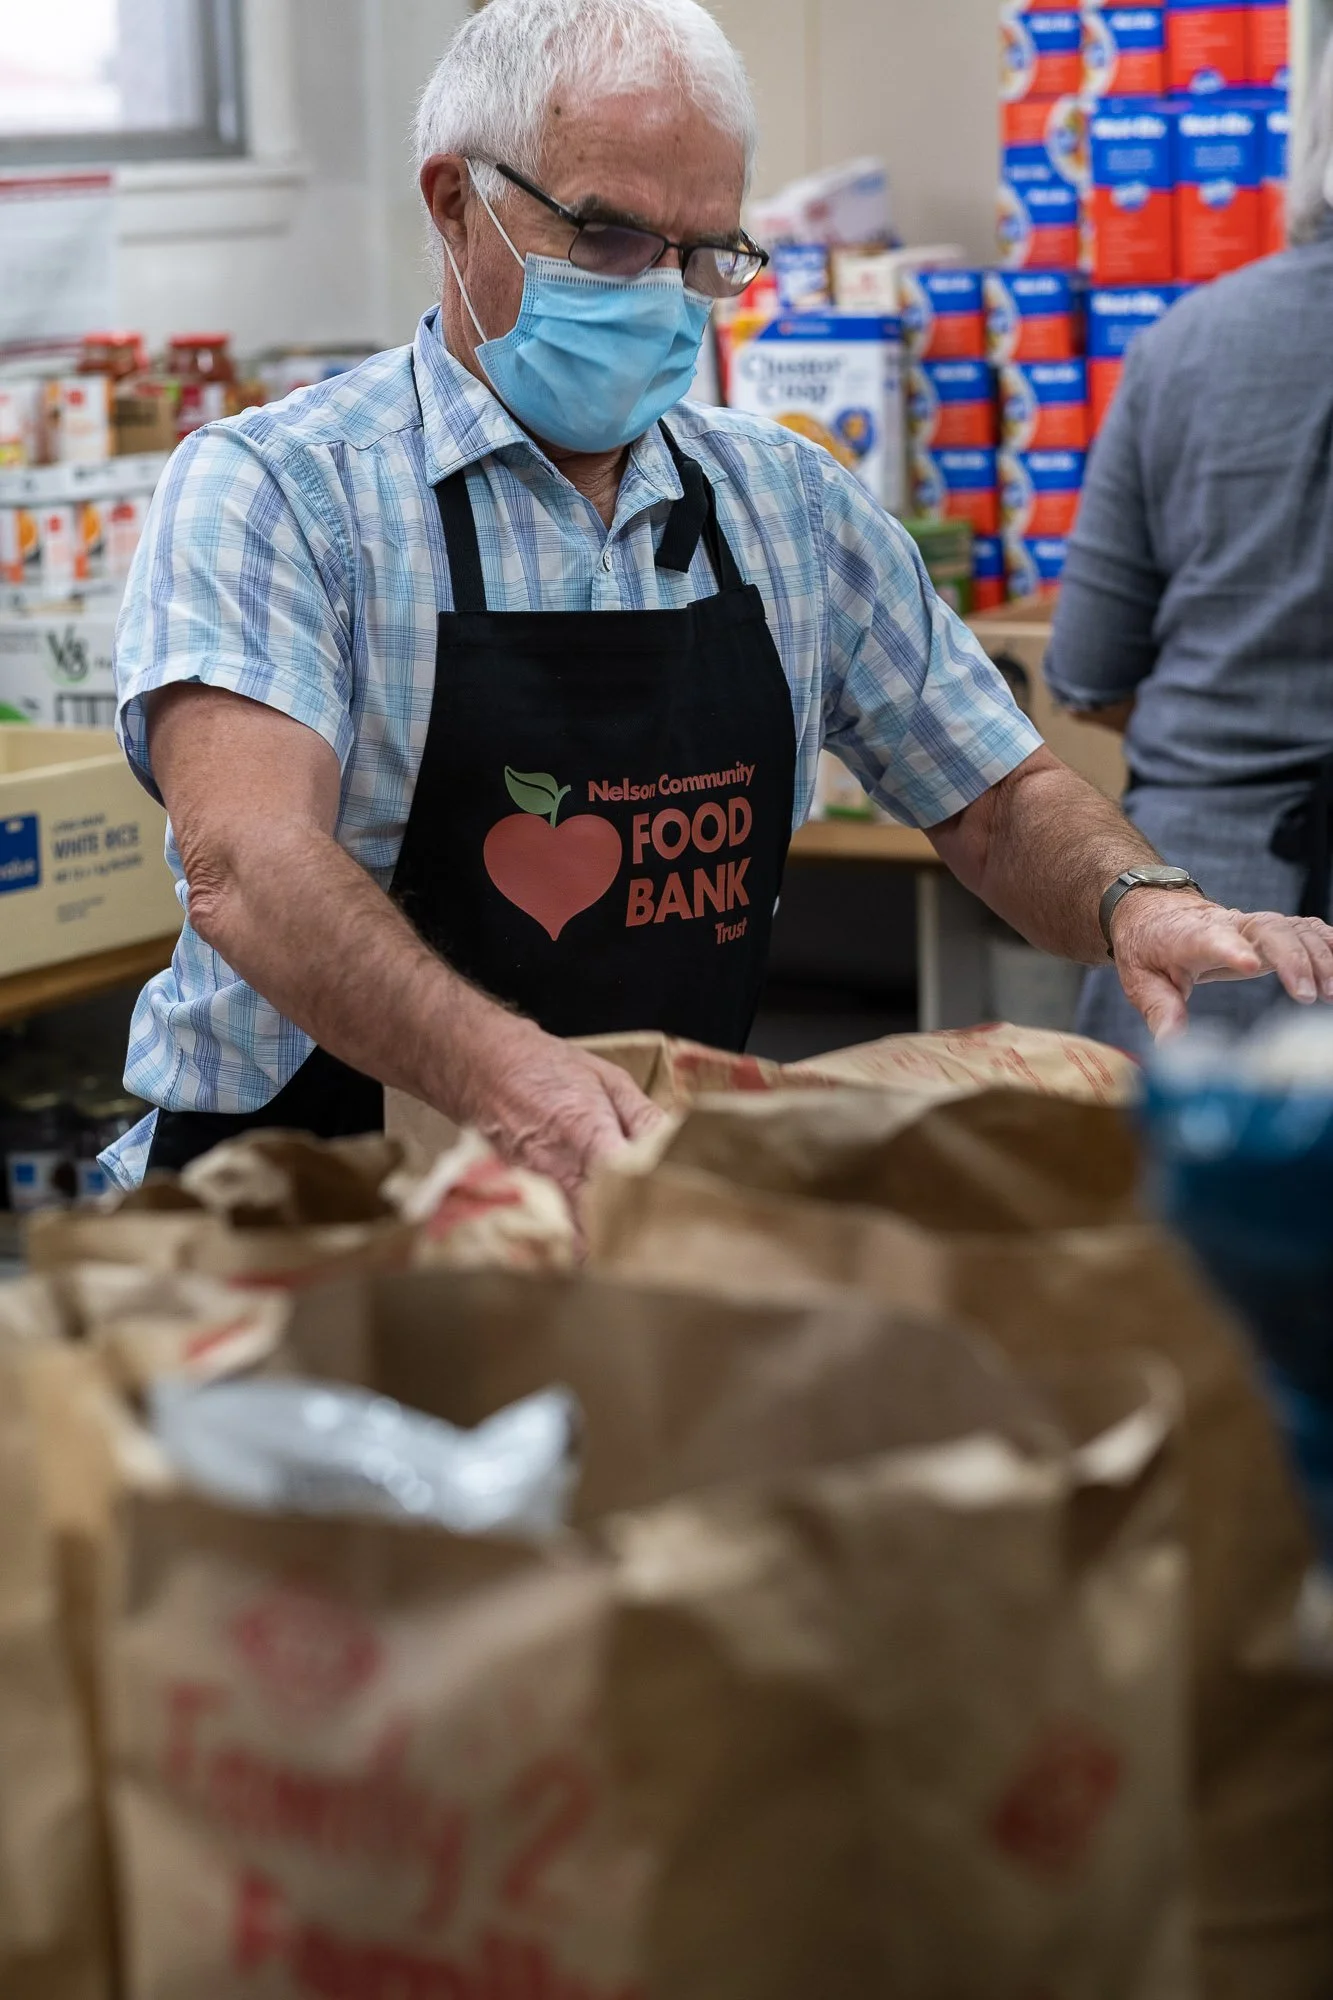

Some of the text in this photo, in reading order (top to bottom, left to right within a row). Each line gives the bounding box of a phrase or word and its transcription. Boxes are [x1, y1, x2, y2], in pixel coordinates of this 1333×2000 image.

[588, 760, 755, 801] Nelson Community
[632, 796, 753, 864] FOOD
[625, 856, 752, 927] BANK
[715, 916, 748, 945] Trust
